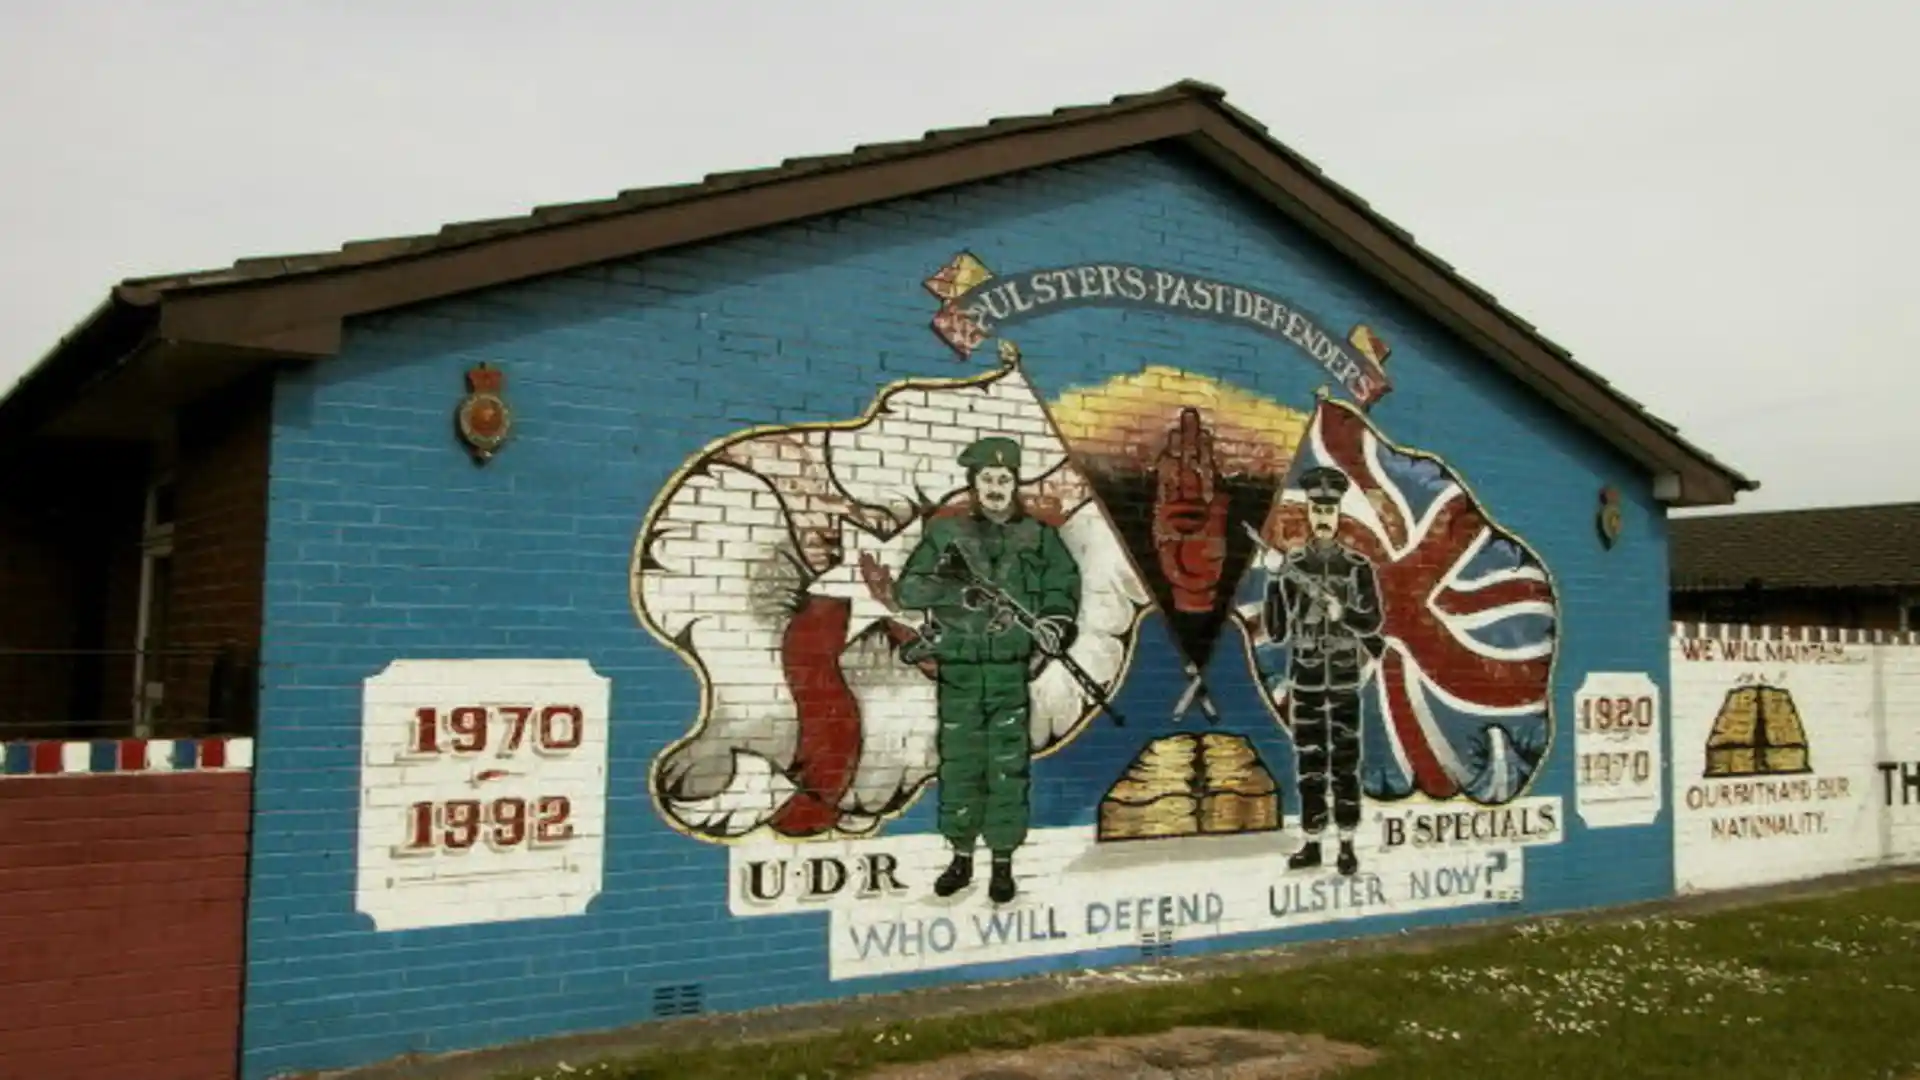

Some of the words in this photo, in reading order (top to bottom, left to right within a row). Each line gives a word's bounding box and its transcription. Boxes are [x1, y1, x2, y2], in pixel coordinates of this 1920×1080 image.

[1679, 637, 1714, 662] WE
[1720, 637, 1761, 663] WILL
[405, 704, 584, 757] 1970
[1579, 696, 1654, 732] 1920
[1579, 750, 1650, 784] 1970
[400, 796, 575, 852] 1992
[849, 915, 958, 960] WHO
[971, 903, 1067, 946] WILL
[1085, 892, 1224, 936] DEFEND
[1268, 875, 1387, 918] ULSTER
